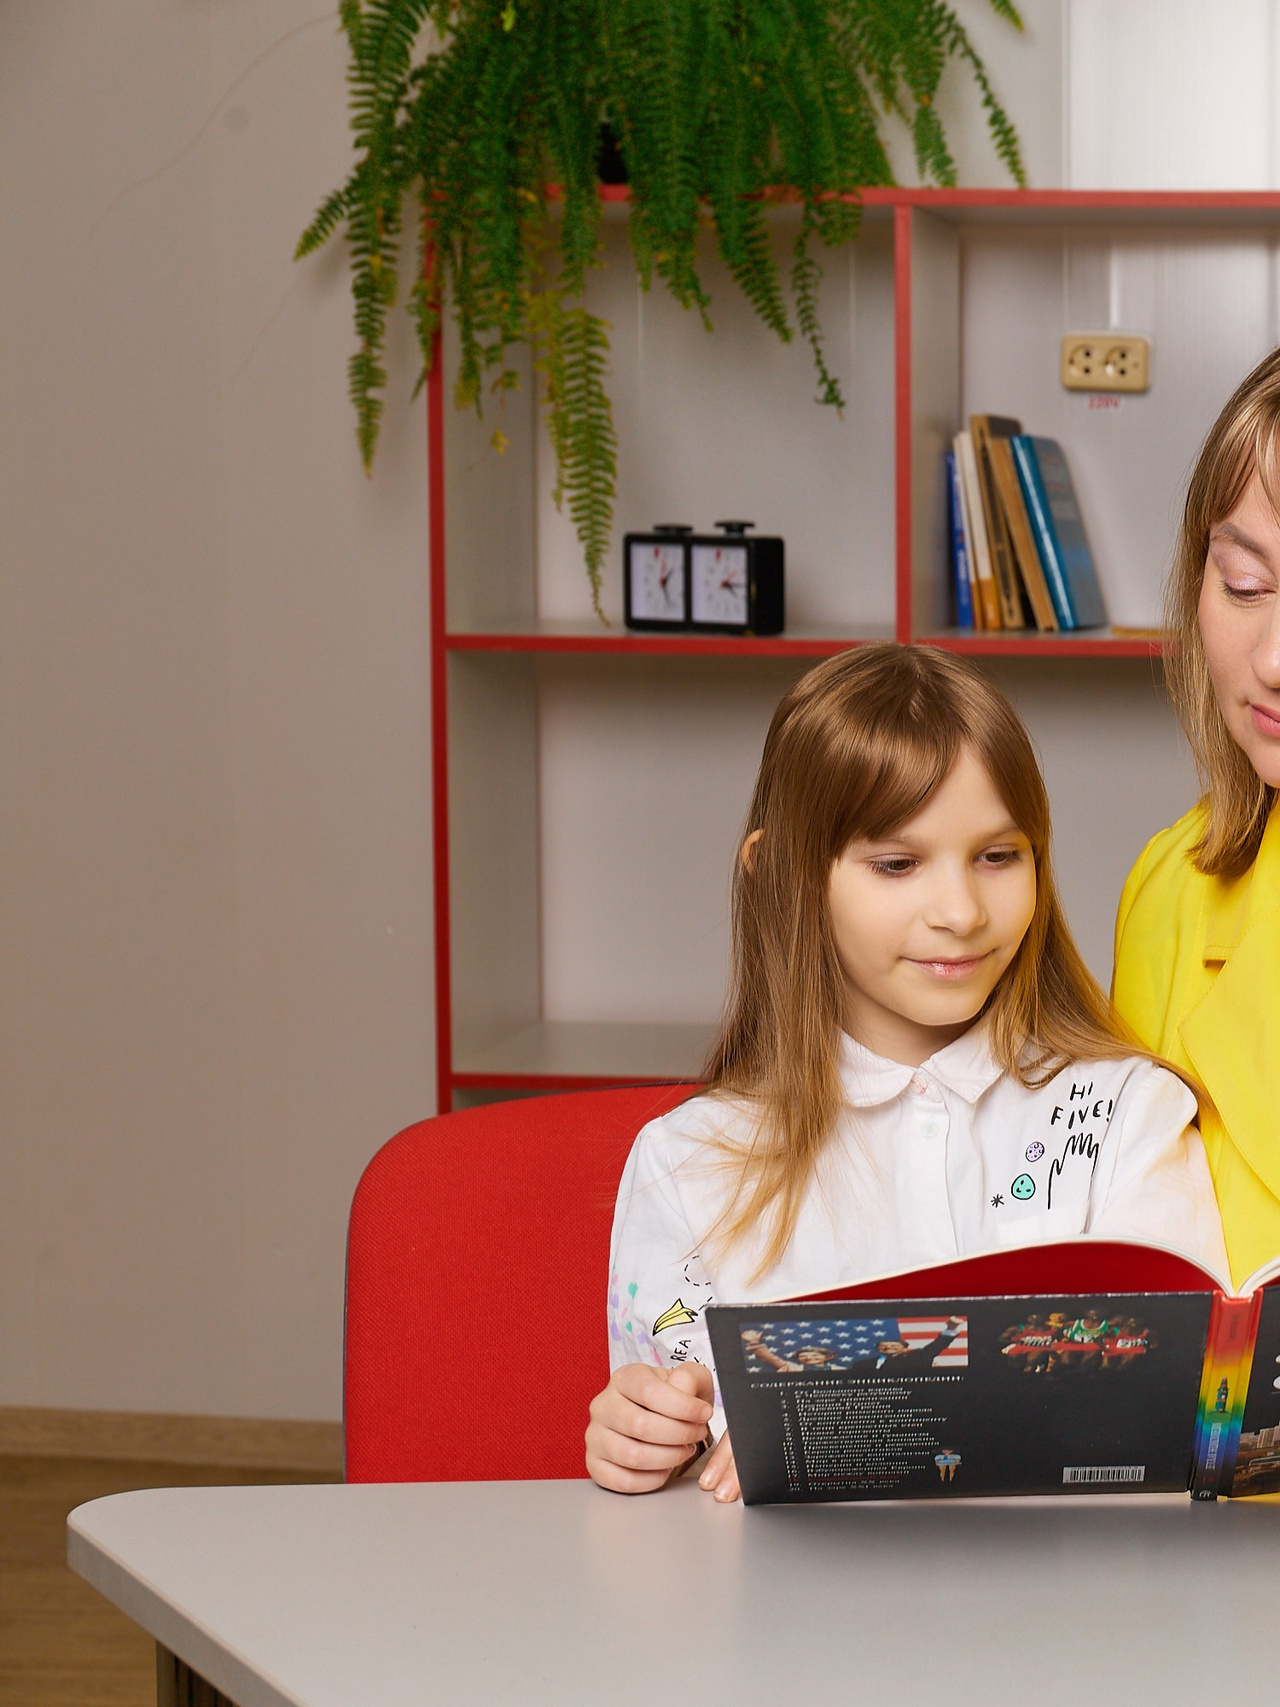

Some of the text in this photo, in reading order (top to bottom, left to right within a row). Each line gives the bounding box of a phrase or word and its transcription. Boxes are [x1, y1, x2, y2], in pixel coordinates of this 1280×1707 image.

[1069, 1081, 1094, 1101] HI
[1050, 1099, 1113, 1129] FIVE!
[750, 1379, 843, 1388] СОДЕРЖАНИЕ
